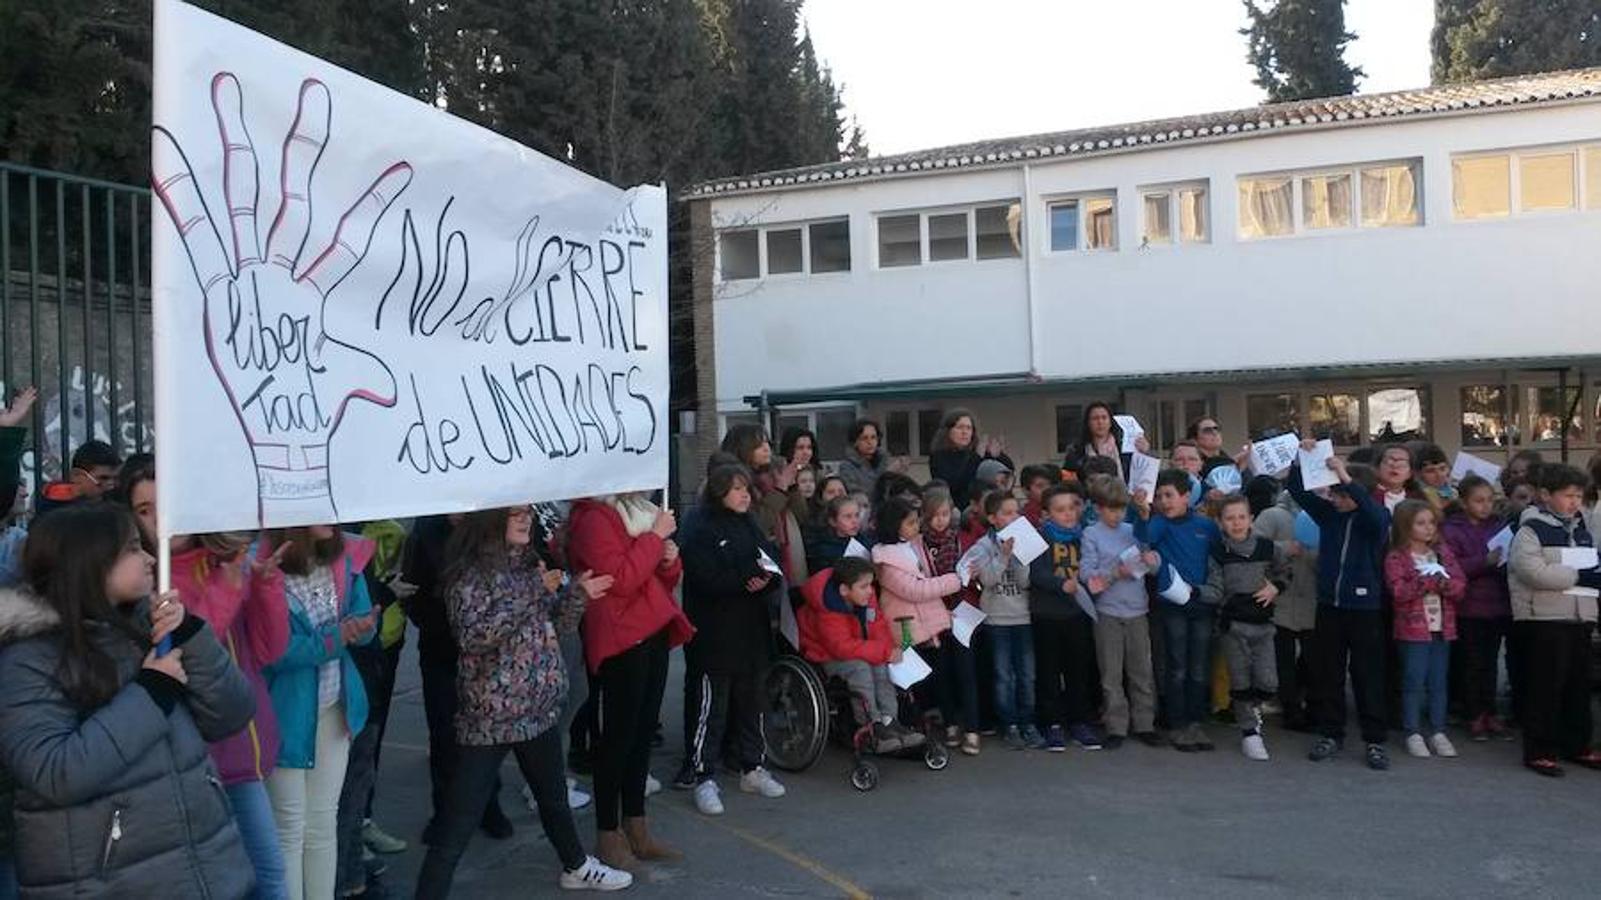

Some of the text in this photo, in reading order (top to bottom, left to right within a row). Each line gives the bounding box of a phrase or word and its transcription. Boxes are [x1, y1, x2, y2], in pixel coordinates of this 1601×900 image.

[504, 235, 648, 353] CIERRE
[398, 361, 657, 474] de UNIDADES
